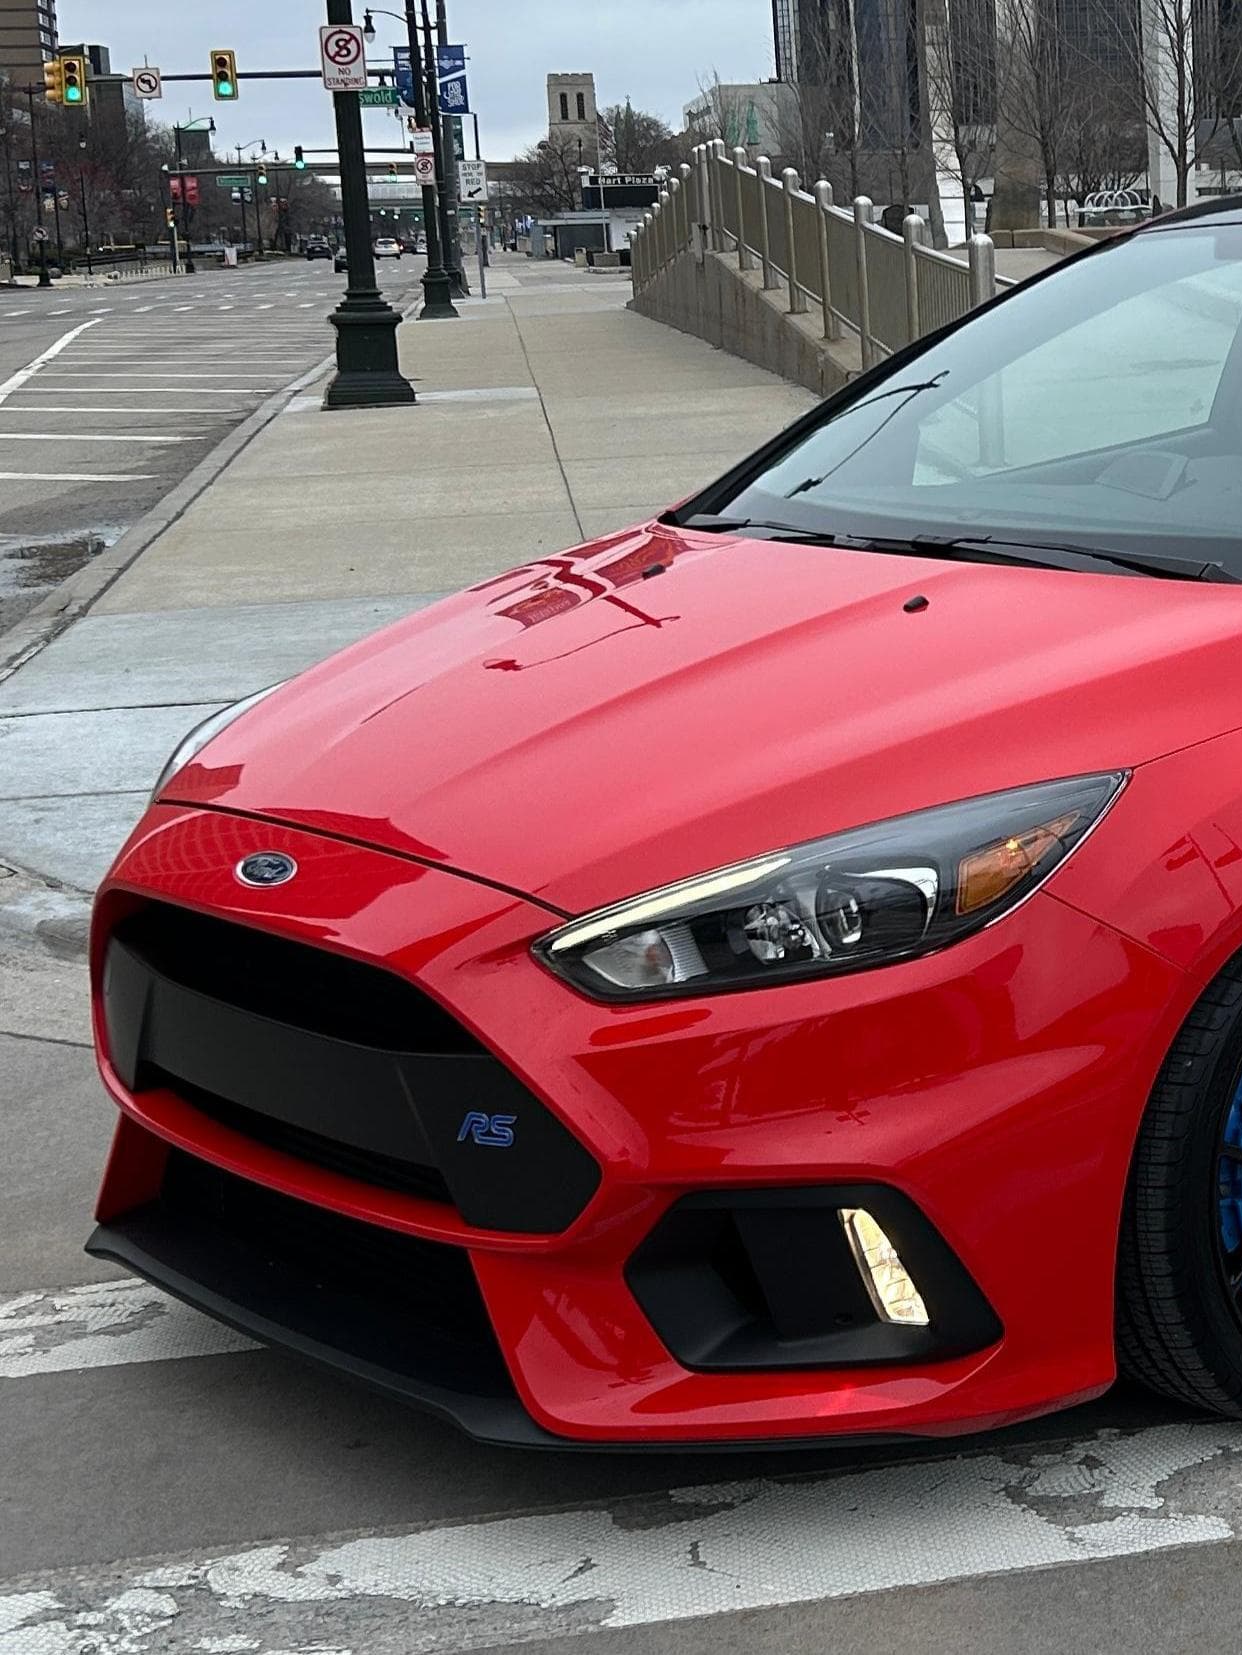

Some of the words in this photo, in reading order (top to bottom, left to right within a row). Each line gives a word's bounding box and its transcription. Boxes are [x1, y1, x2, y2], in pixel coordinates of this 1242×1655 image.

[338, 67, 351, 76] NO
[462, 163, 482, 171] STOP
[598, 176, 621, 185] Hart
[625, 176, 654, 185] Plaza
[457, 1111, 517, 1147] RS
